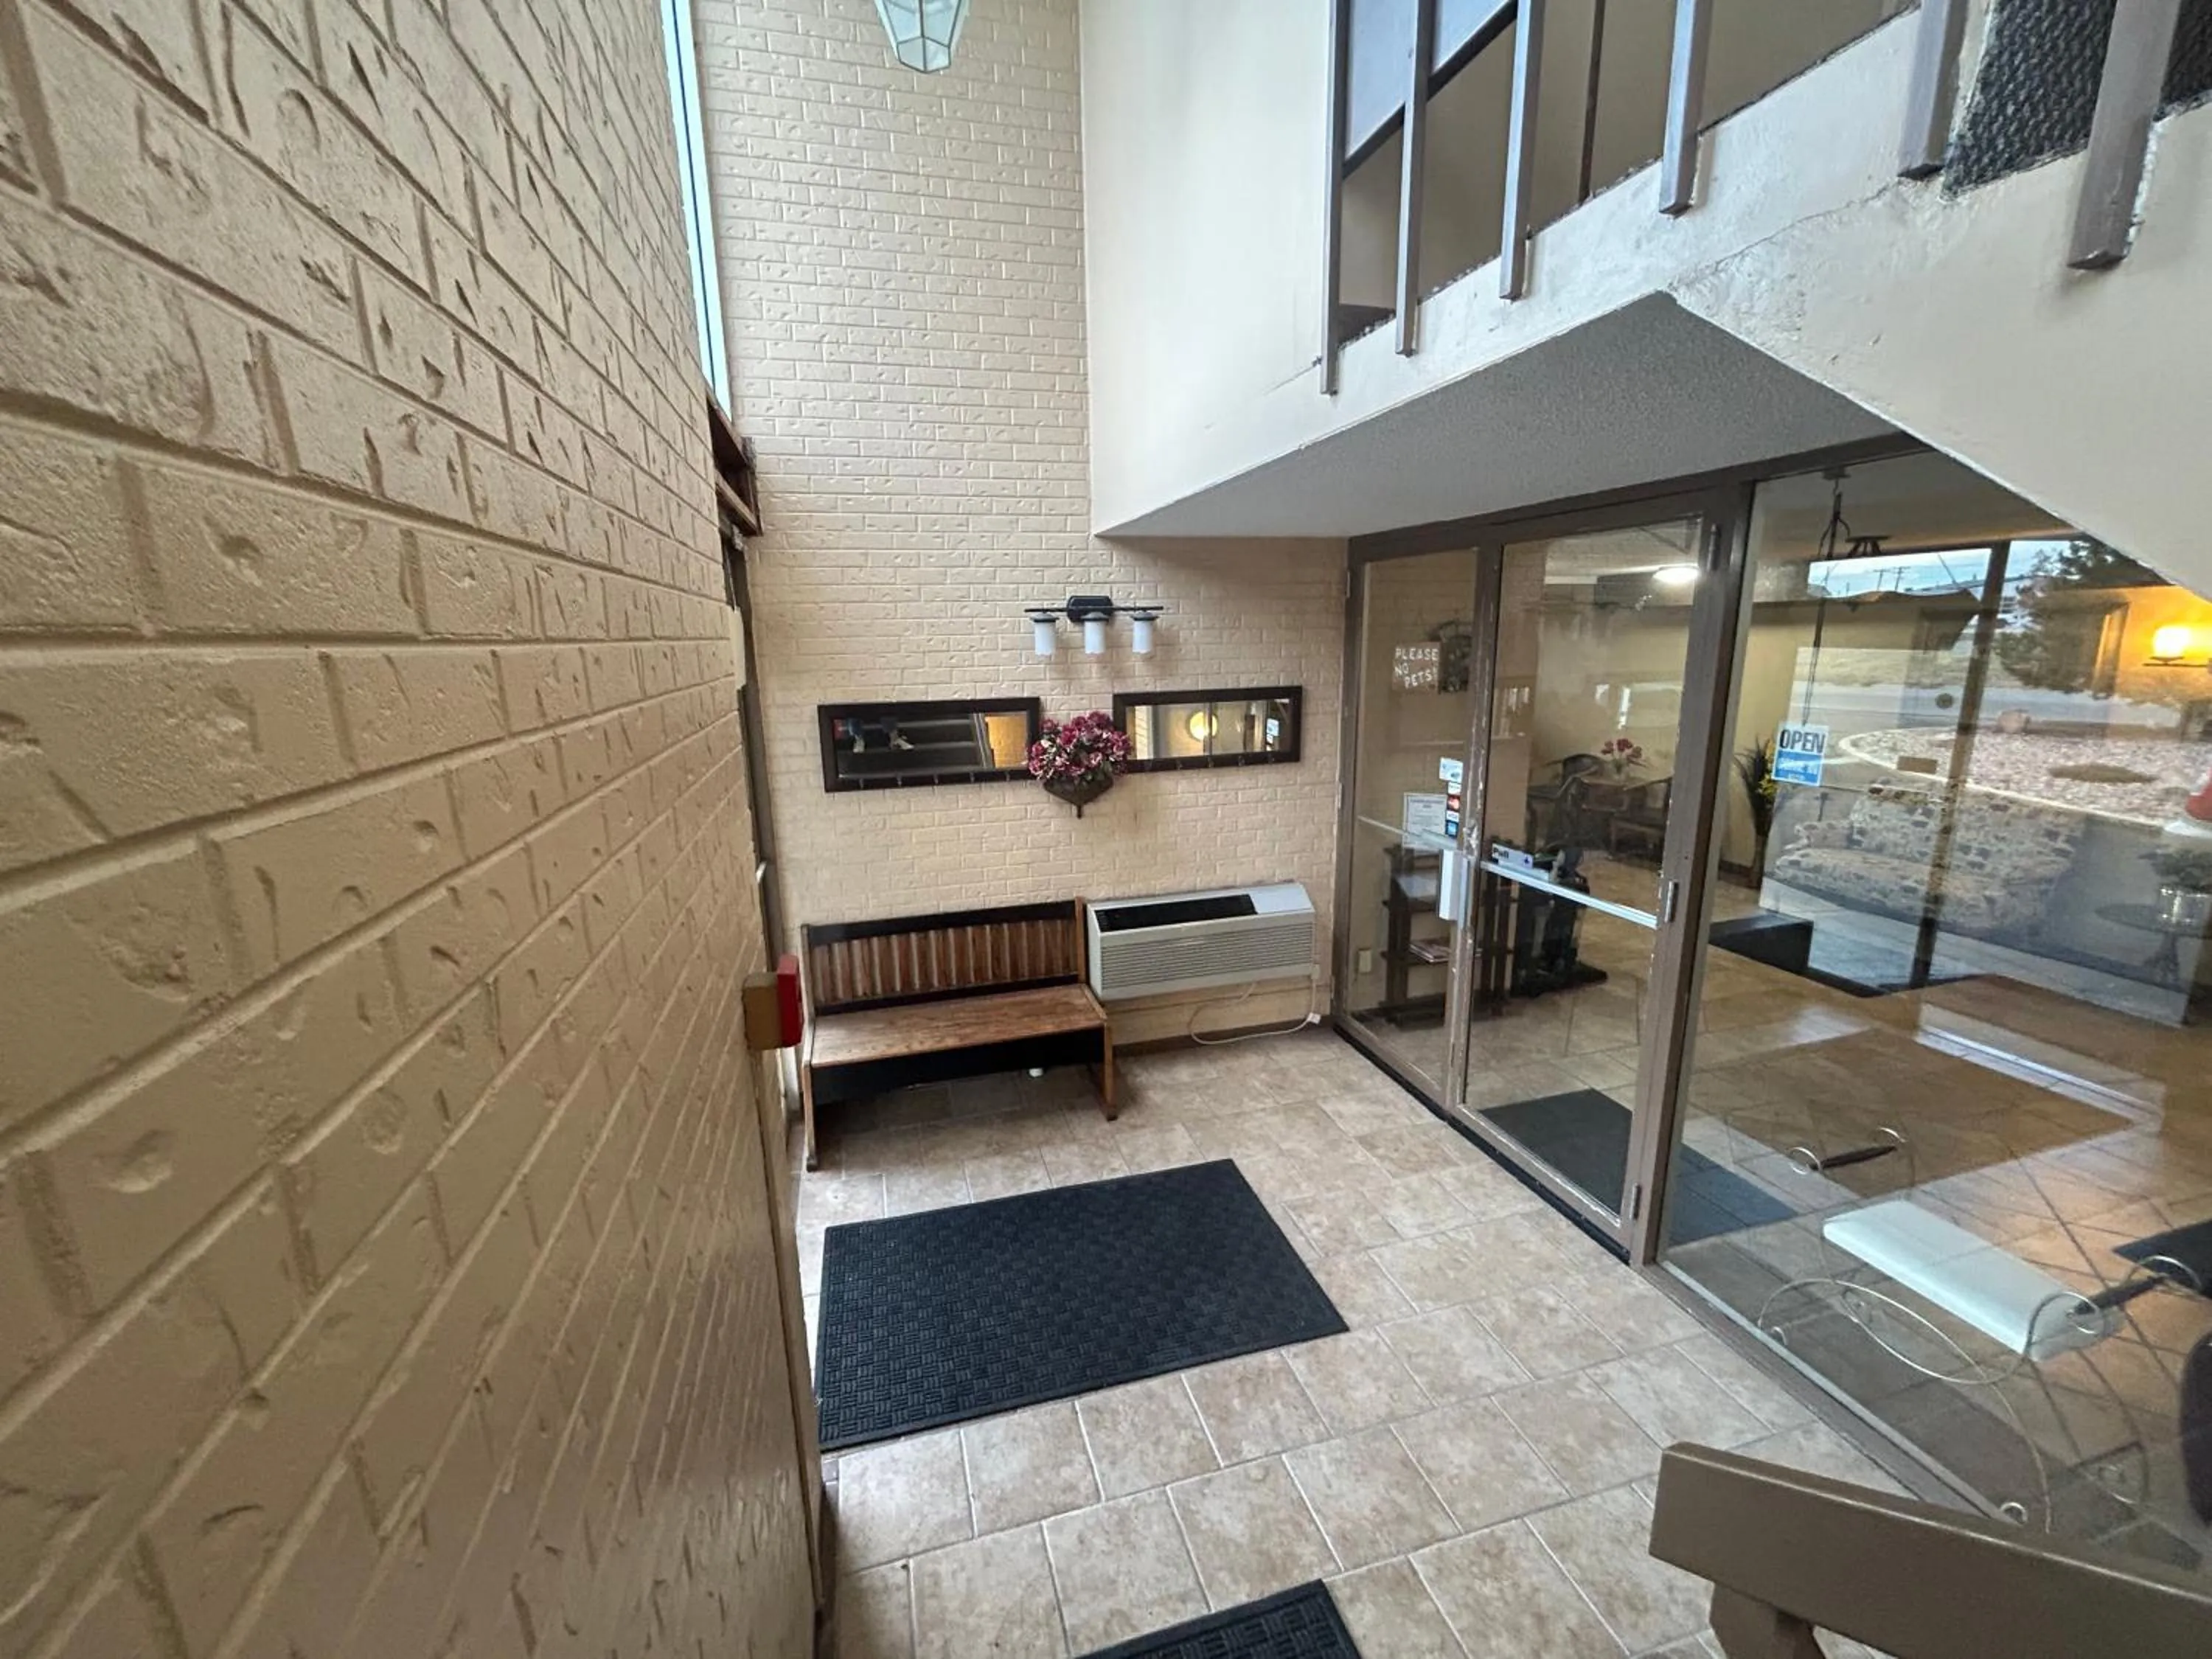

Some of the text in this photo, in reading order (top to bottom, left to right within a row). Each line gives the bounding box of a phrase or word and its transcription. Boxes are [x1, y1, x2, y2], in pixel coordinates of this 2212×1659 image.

[1395, 647, 1439, 661] PLEASE
[1395, 663, 1409, 676] NO
[1780, 729, 1826, 754] OPEN
